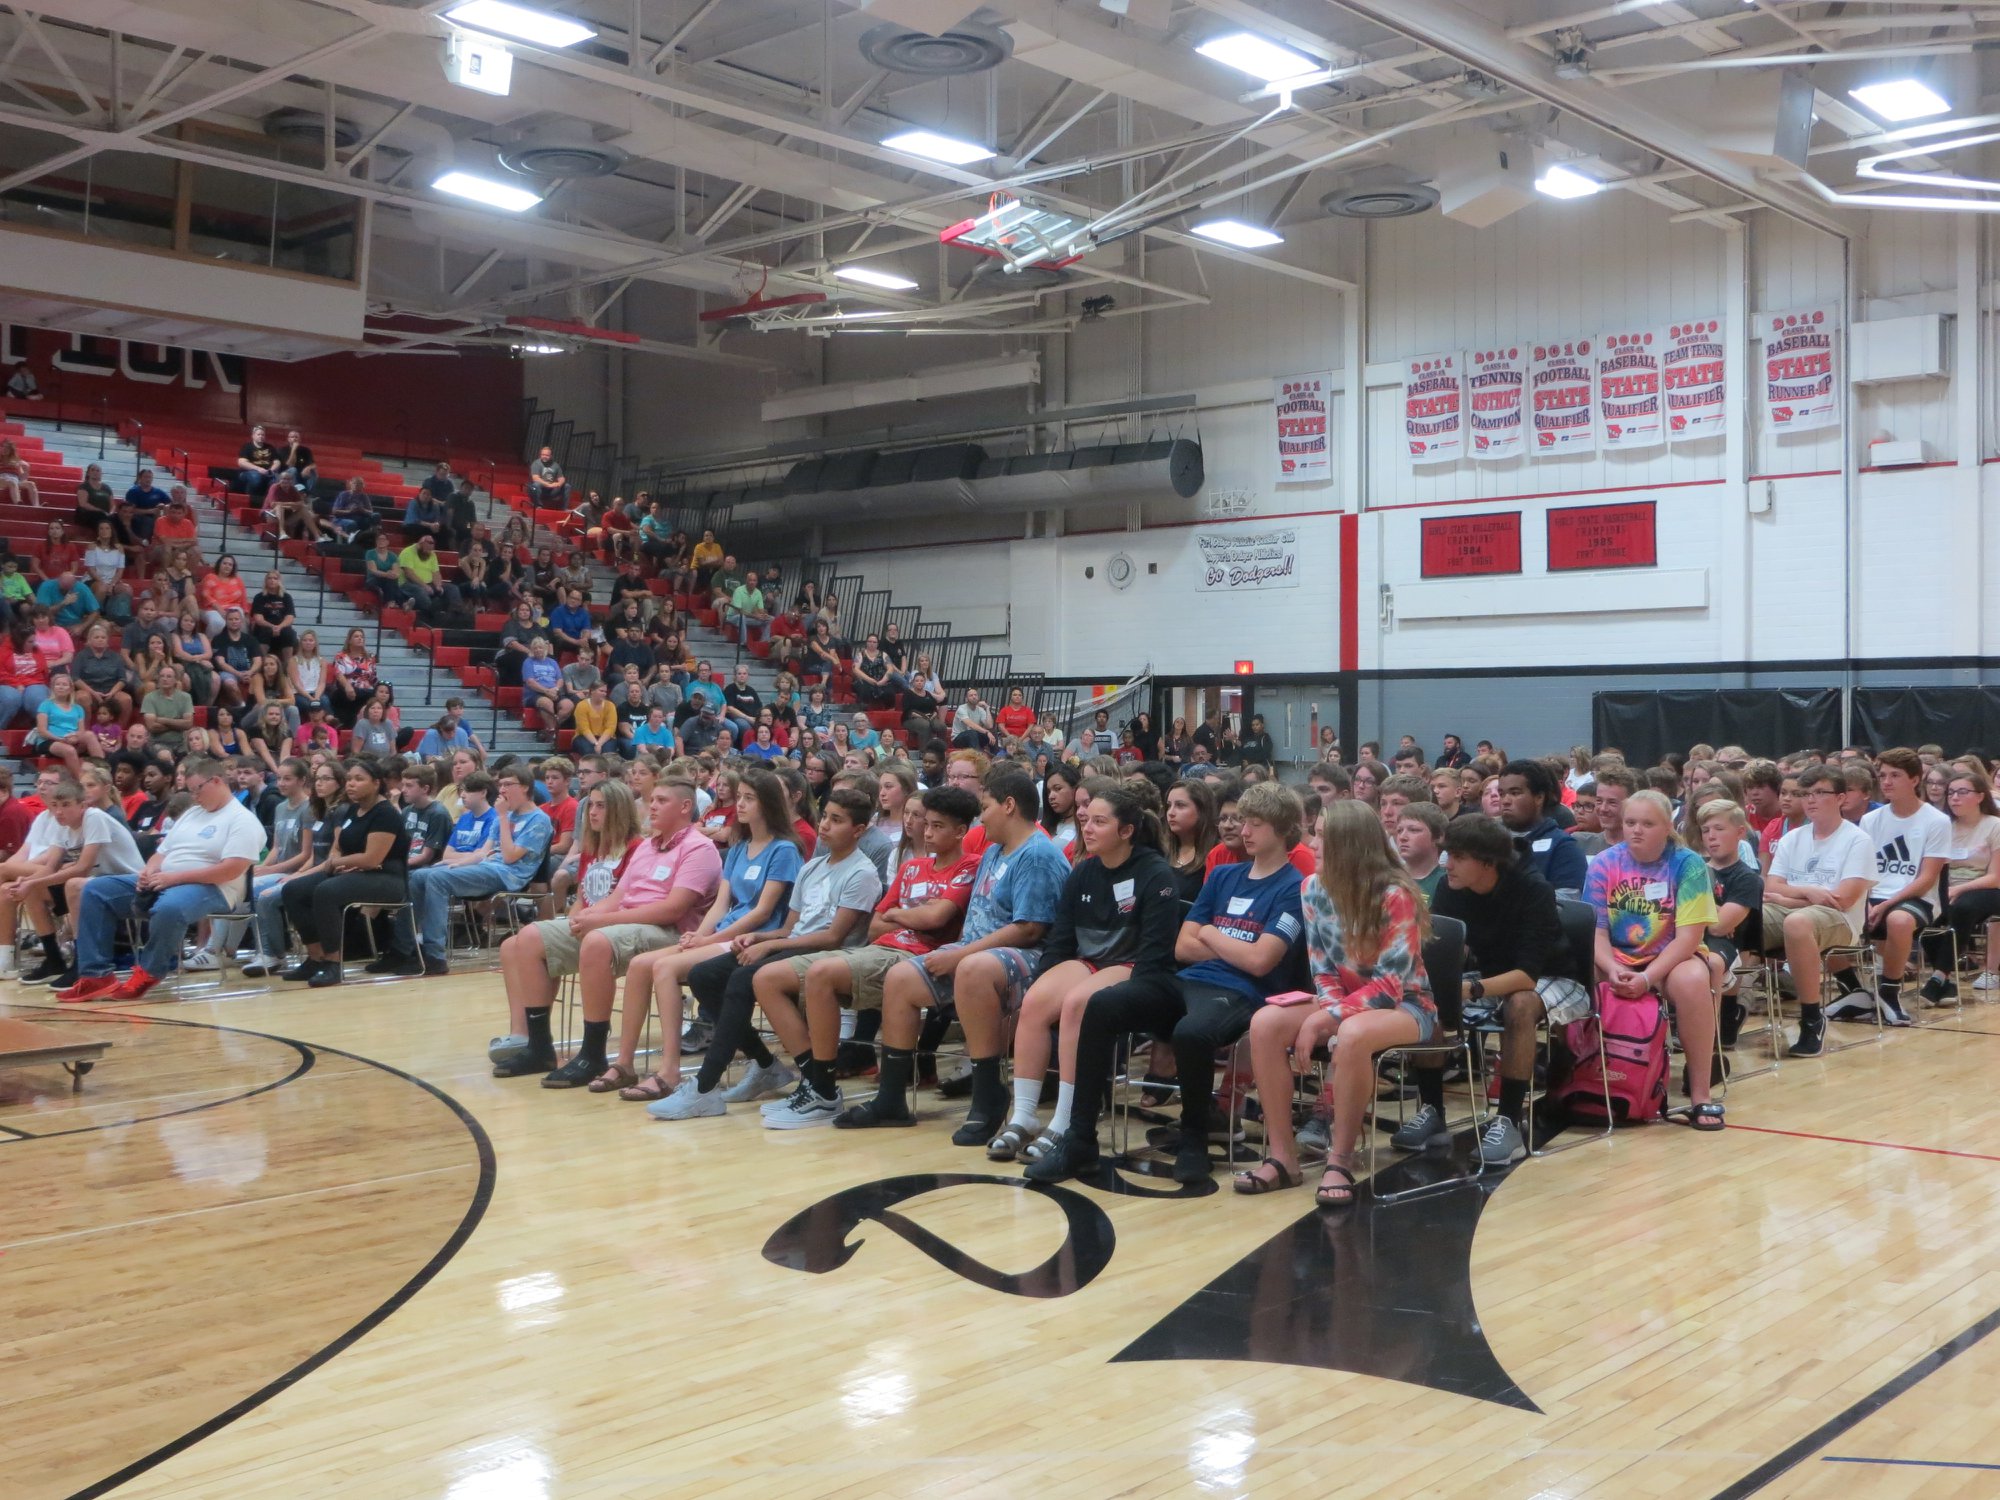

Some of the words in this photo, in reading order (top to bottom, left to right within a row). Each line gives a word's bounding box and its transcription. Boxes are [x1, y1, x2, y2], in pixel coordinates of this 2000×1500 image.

[1677, 334, 1698, 345] CLASS
[1767, 334, 1830, 359] BASEBALL
[1475, 348, 1518, 364] 2010
[1534, 341, 1590, 361] 2010
[1664, 345, 1689, 366] TEAM
[1690, 343, 1723, 359] TENNIS
[1411, 357, 1453, 374] 2011
[1482, 362, 1501, 372] CLASS
[1600, 354, 1658, 375] BASEBALL
[1665, 361, 1724, 390] STATE
[1767, 350, 1830, 381] STATE
[1407, 377, 1459, 399] BASEBALL
[1470, 371, 1522, 388] TENNIS
[1533, 367, 1591, 389] FOOTBALL
[1601, 373, 1658, 398] STATE
[1768, 374, 1832, 402] RUNNER-UP
[1277, 400, 1326, 417] FOOTBALL
[1406, 393, 1459, 418] STATE
[1534, 385, 1590, 411] STATE
[1601, 395, 1658, 419] QUALIFIER
[1278, 416, 1327, 437] STATE
[1406, 414, 1459, 437] QUALIFIER
[1534, 407, 1590, 430] QUALIFIER
[1447, 534, 1494, 545] CHAMPIONS
[1575, 525, 1626, 537] CHAMPIONS
[1206, 567, 1224, 586] Go
[1229, 554, 1294, 586] Dodgers!!
